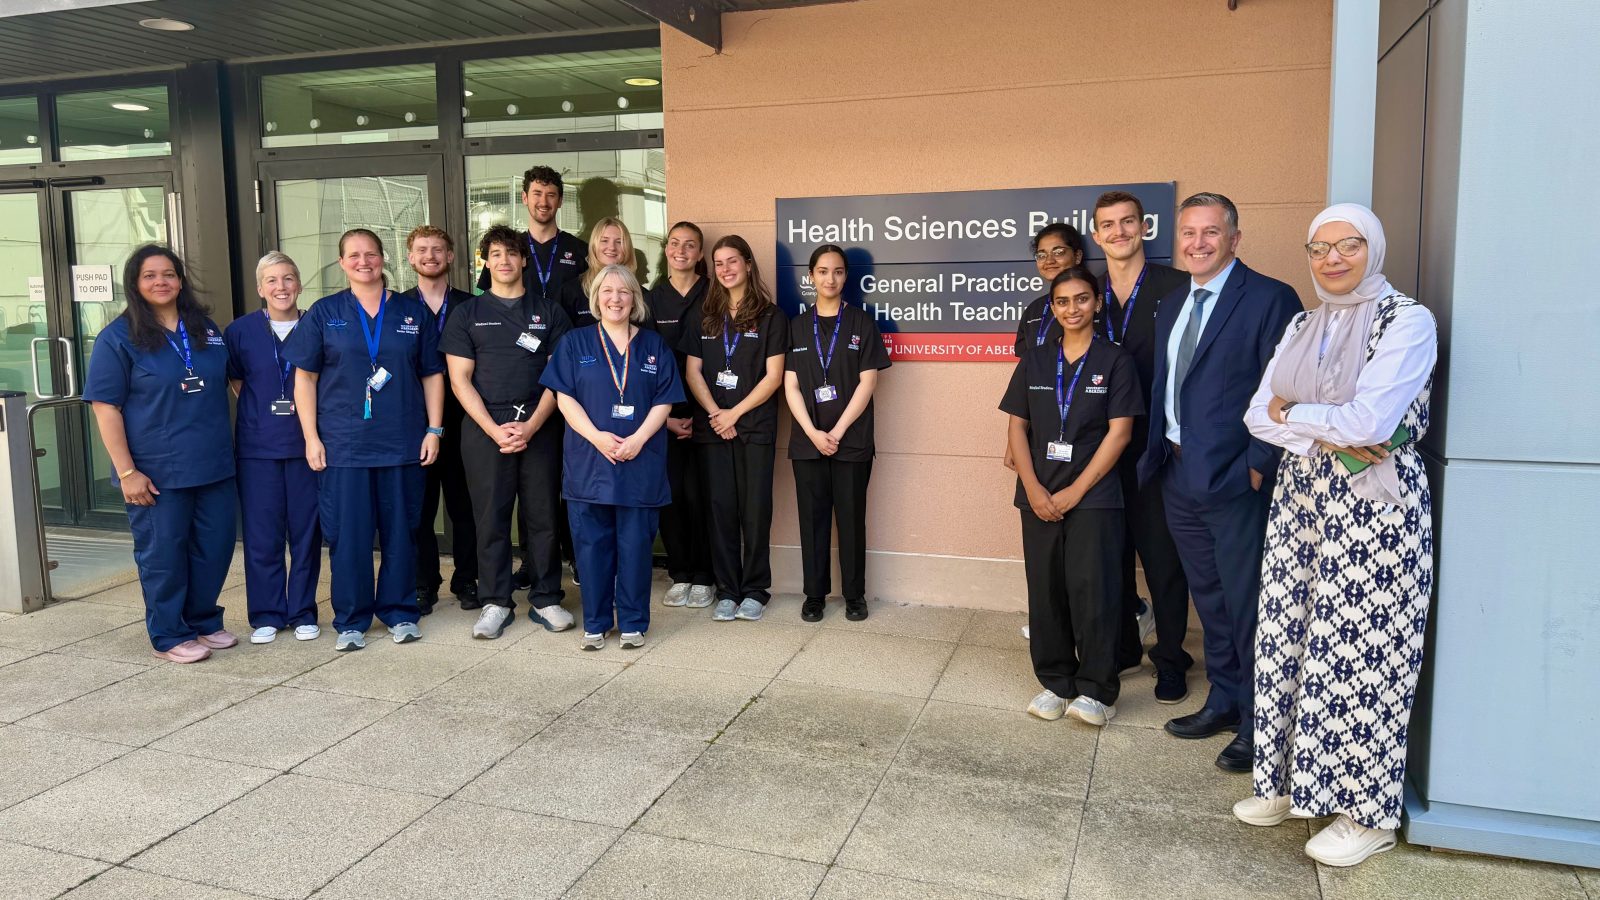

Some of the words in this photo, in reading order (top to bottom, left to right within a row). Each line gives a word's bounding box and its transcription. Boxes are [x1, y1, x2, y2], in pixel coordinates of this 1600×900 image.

[788, 217, 874, 243] Health
[884, 215, 1017, 241] Sciences
[1028, 209, 1159, 241] Bilg
[860, 273, 943, 293] General
[951, 273, 1043, 292] Practice
[874, 302, 942, 321] Health
[950, 301, 1028, 321] Teachi
[895, 344, 965, 355] UNIVERSITY
[966, 344, 982, 355] OF
[985, 344, 1016, 355] ABER
